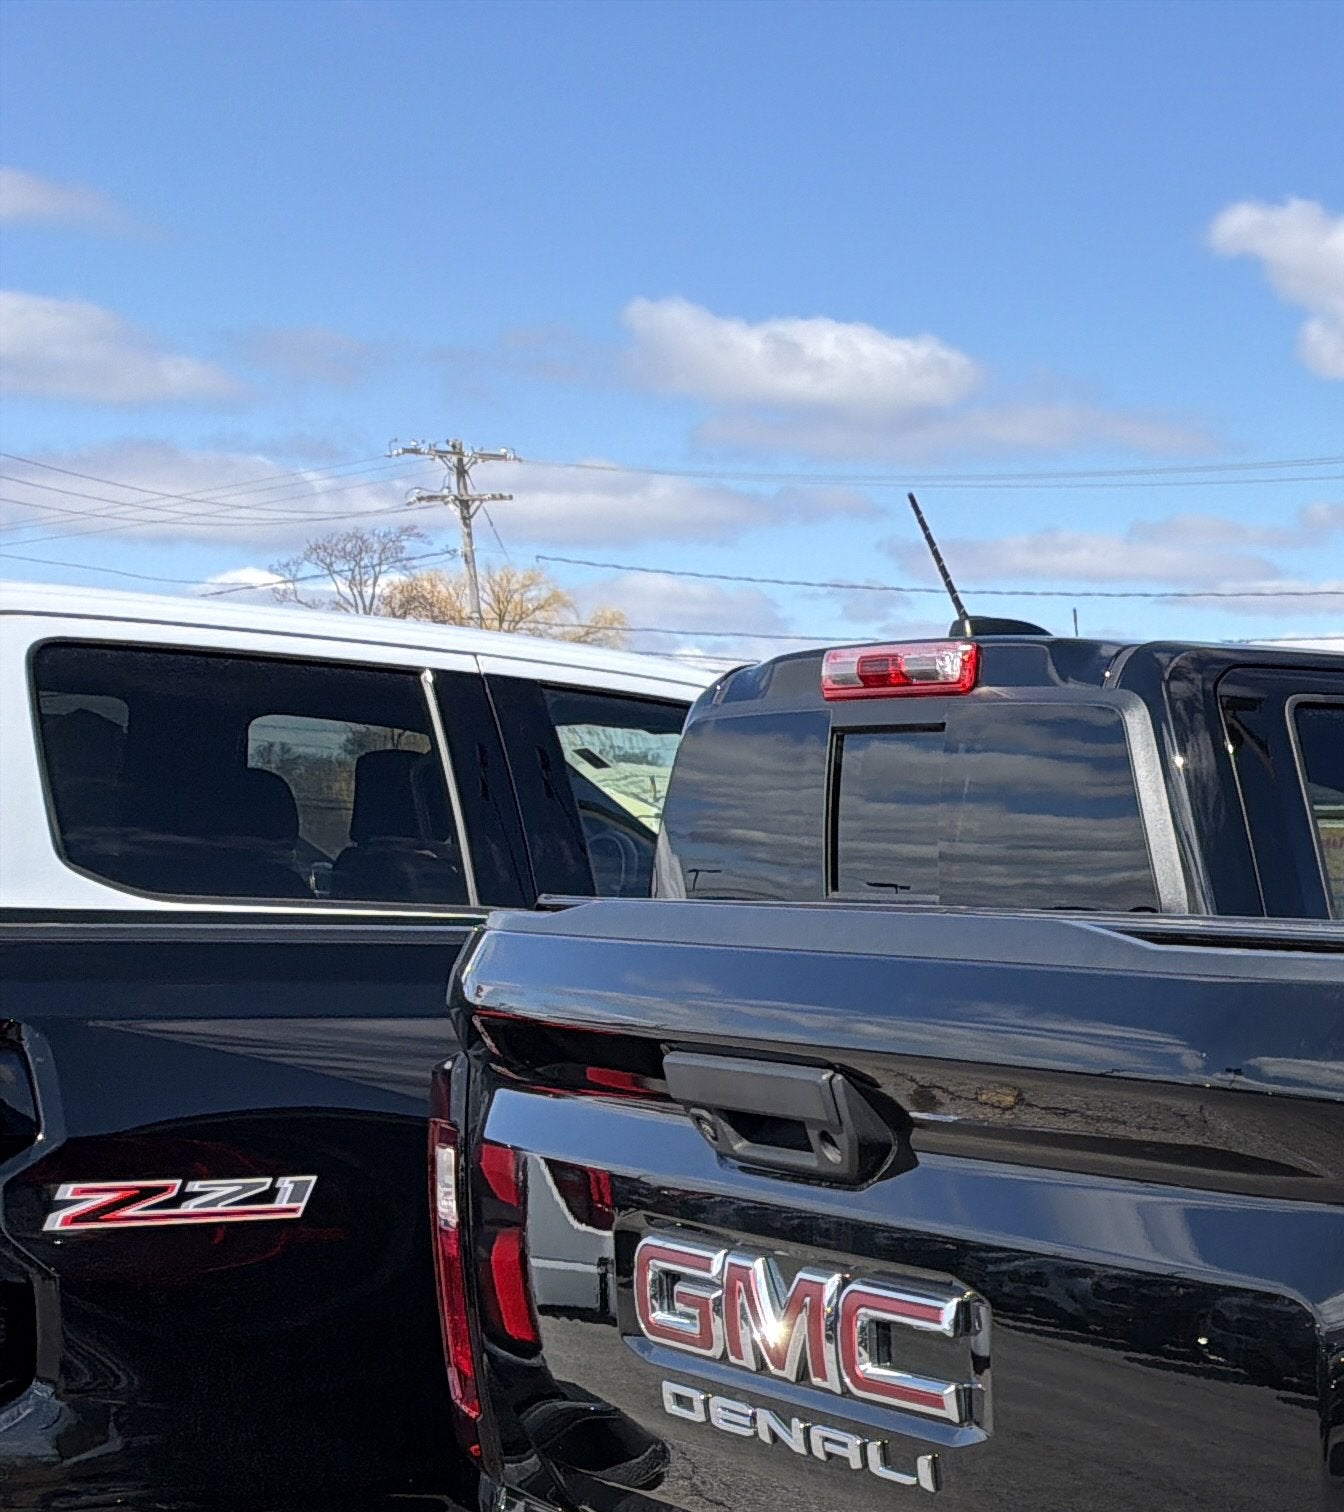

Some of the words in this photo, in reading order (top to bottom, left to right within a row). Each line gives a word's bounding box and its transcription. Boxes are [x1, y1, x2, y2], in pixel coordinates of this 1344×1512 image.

[42, 1175, 318, 1231] Z71
[633, 1235, 973, 1424] GMC
[661, 1379, 940, 1493] DENALI
